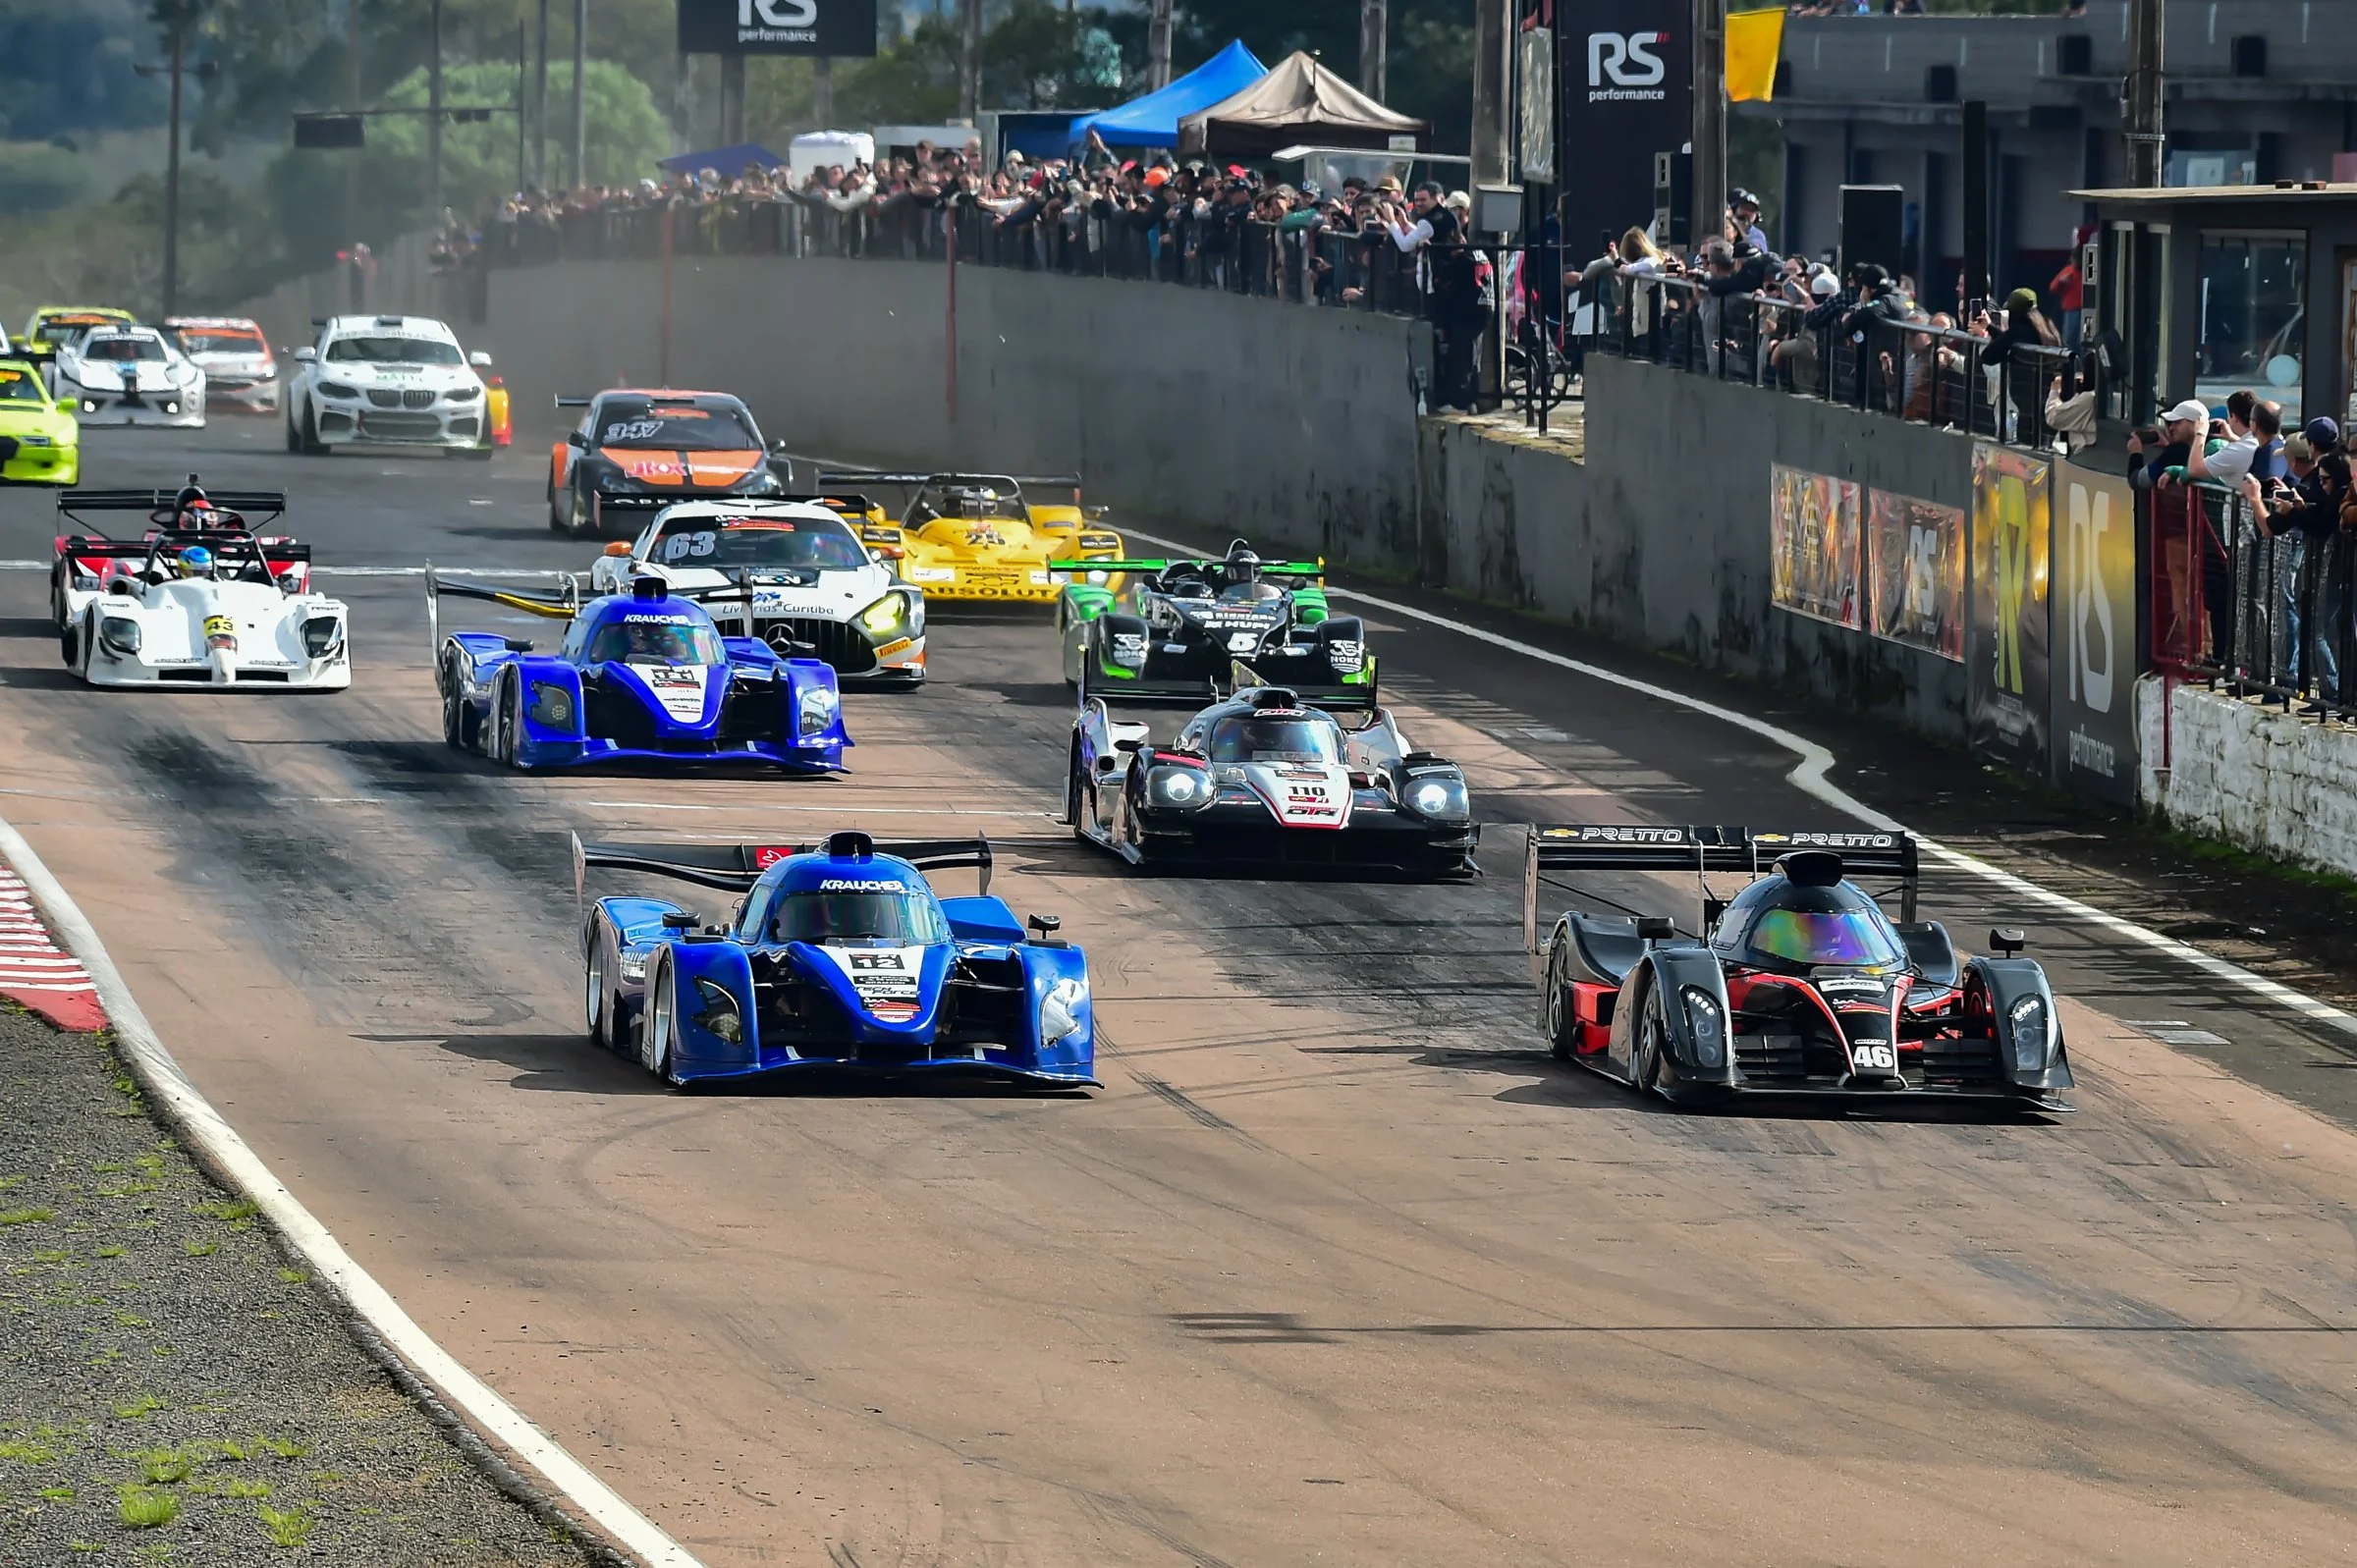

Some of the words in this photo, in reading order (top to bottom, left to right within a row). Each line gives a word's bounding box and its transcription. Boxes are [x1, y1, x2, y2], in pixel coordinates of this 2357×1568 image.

[738, 27, 816, 42] performance
[1588, 31, 1665, 86] RS
[1589, 88, 1665, 103] performance
[664, 531, 716, 560] 63
[723, 605, 777, 614] Livrrias
[784, 604, 834, 615] Curitiba
[1288, 786, 1326, 796] 110
[1582, 828, 1682, 842] PRETTO
[1791, 833, 1891, 847] PRETTO
[820, 880, 905, 891] KRAUCHER
[857, 958, 899, 968] 12
[1853, 1046, 1893, 1068] 46
